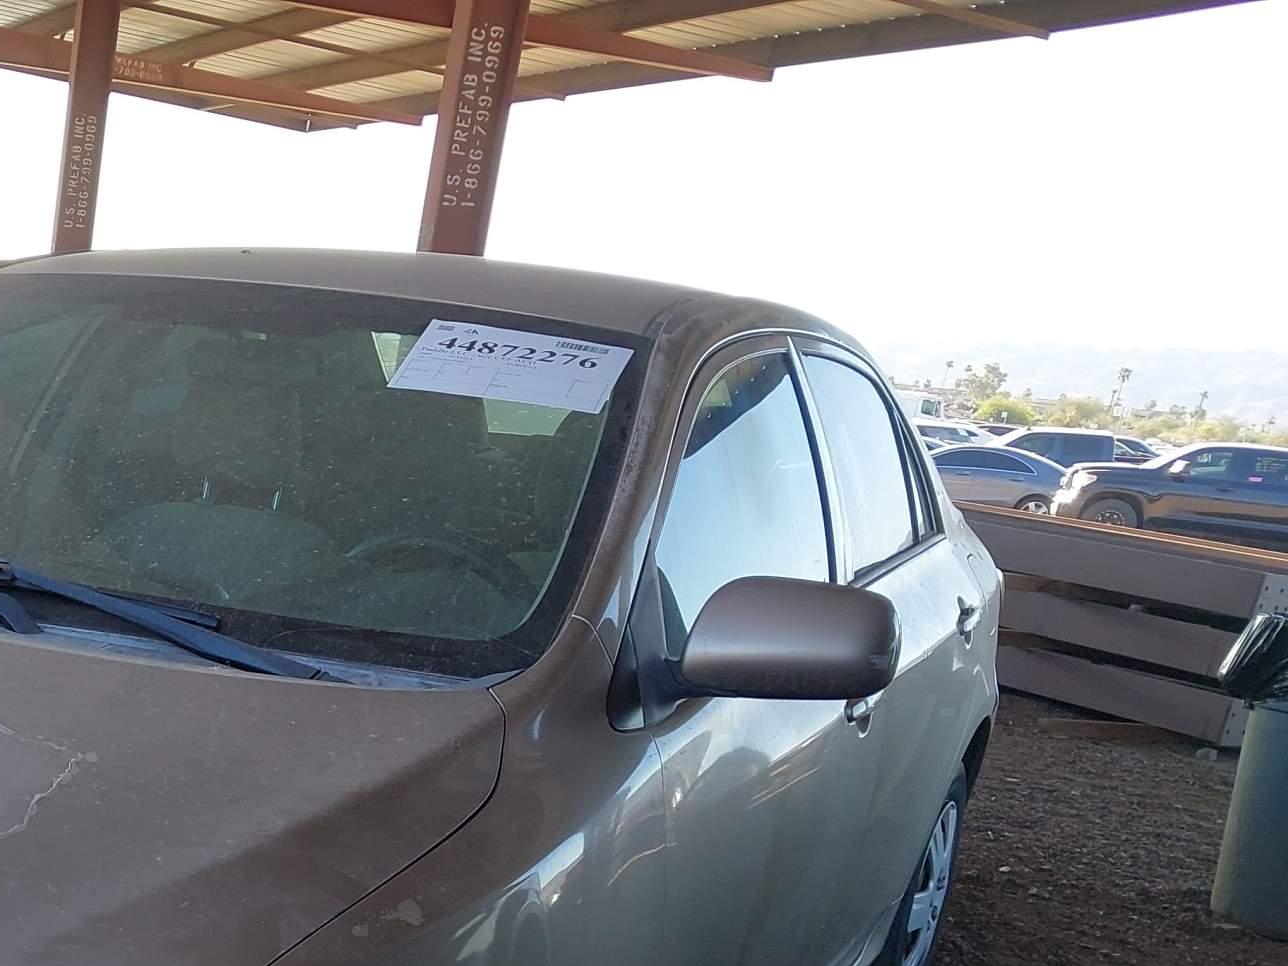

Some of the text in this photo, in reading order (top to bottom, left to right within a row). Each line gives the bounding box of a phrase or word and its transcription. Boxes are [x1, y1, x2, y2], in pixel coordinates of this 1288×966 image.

[64, 113, 87, 229] U.S. PREFAB INC.
[75, 115, 97, 228] 1-866-799-0969
[442, 23, 488, 206] U.S. PREFAB INC.
[461, 25, 505, 207] 1-866-799-0969
[437, 336, 602, 370] 44872276
